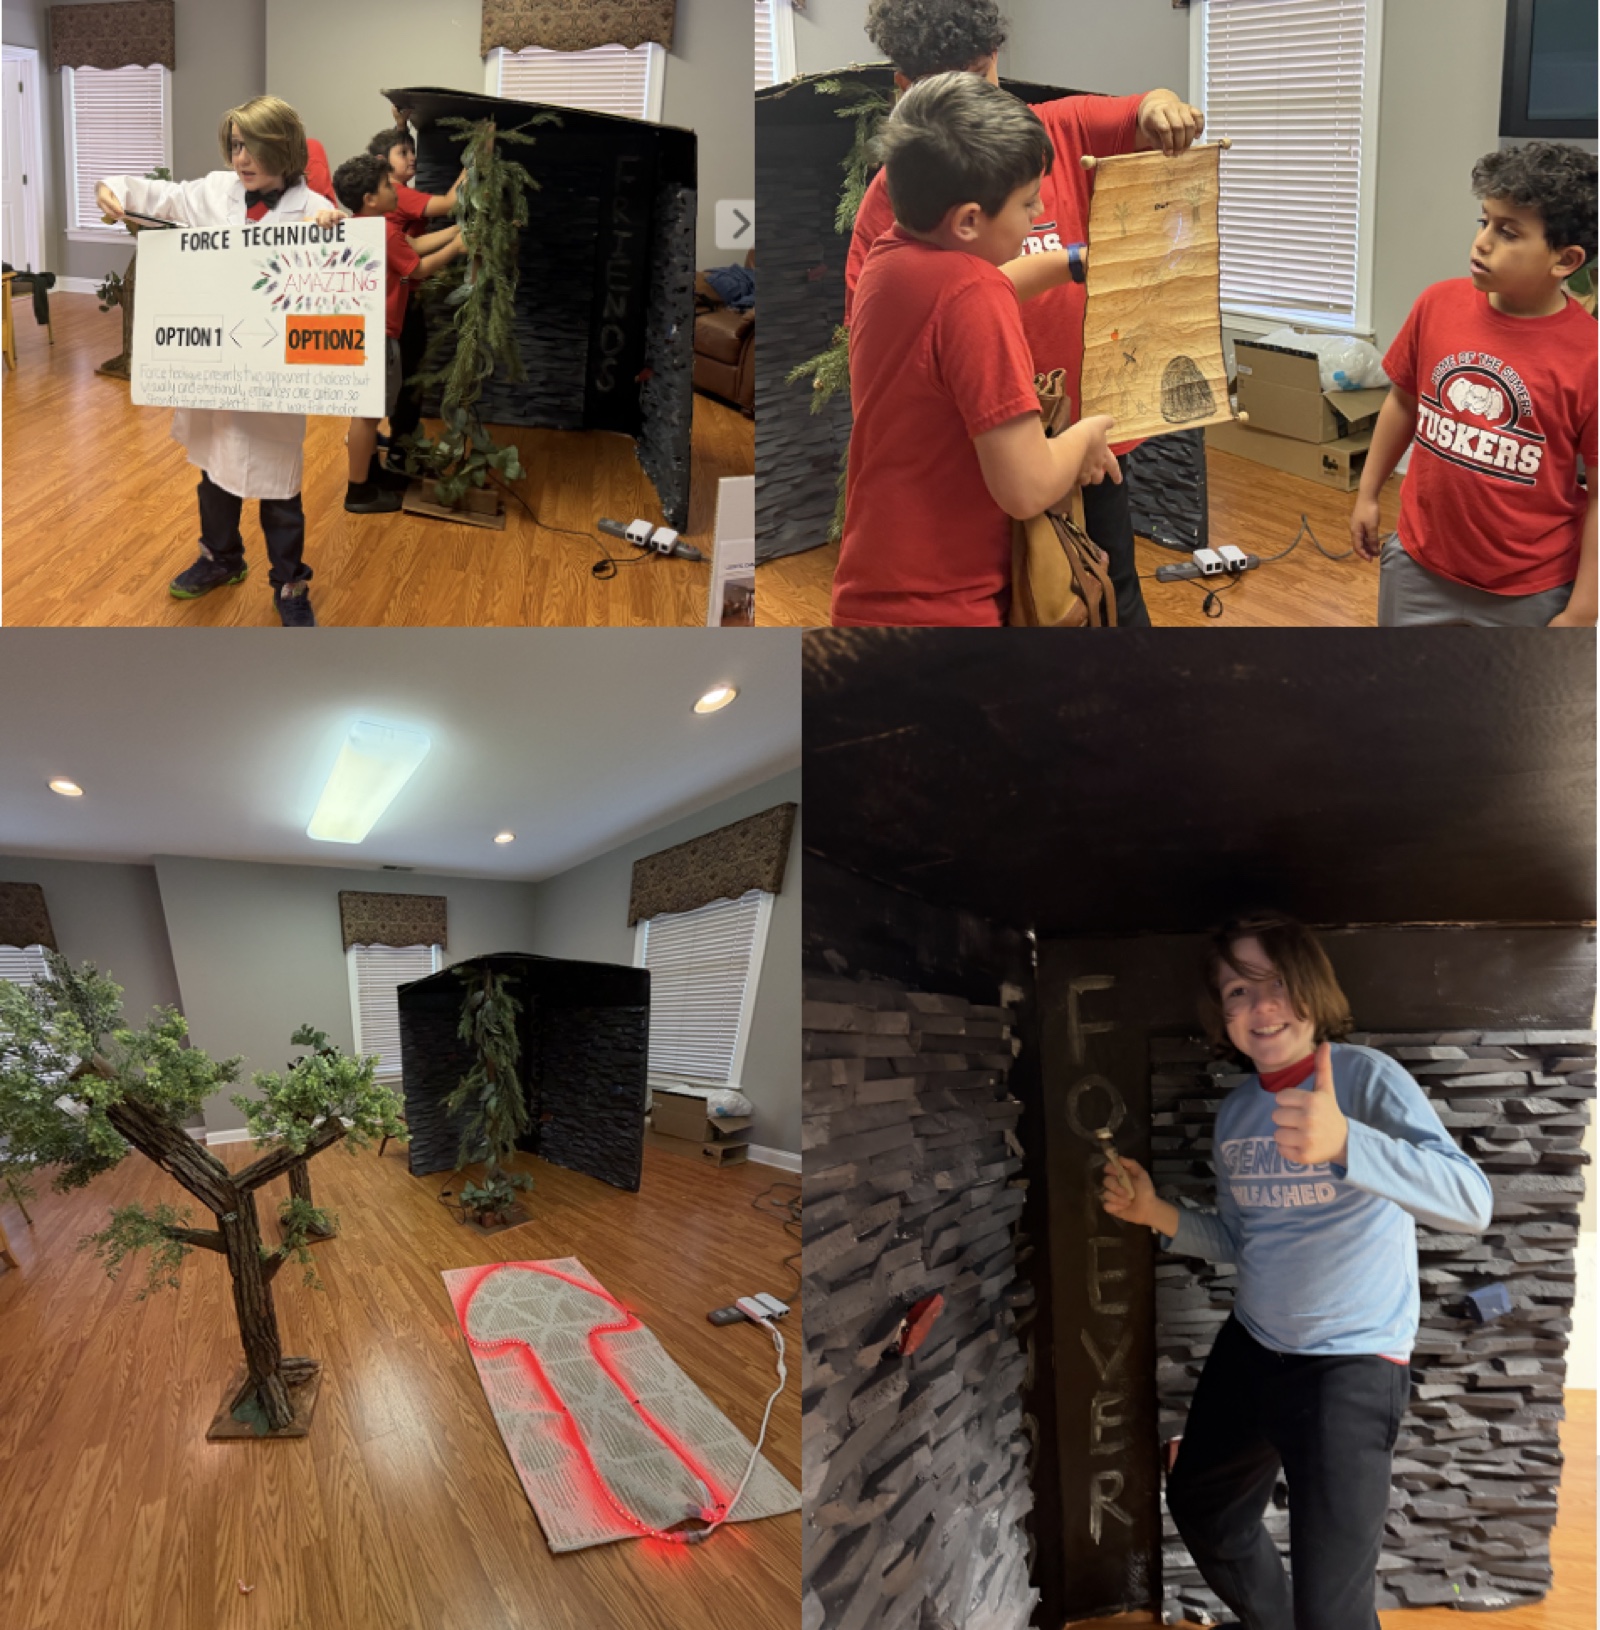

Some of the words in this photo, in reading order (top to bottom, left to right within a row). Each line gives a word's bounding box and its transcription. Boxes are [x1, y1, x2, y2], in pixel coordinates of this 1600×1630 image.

[181, 230, 230, 252] FORCE
[242, 222, 346, 248] TECHNIQUE
[283, 270, 378, 293] AMAZING
[595, 154, 642, 393] FRIENDS
[1458, 351, 1476, 365] OF
[1478, 352, 1504, 371] THE
[140, 363, 166, 379] Force
[313, 371, 351, 385] choices
[353, 371, 371, 386] but
[1417, 402, 1543, 475] TUSKERS
